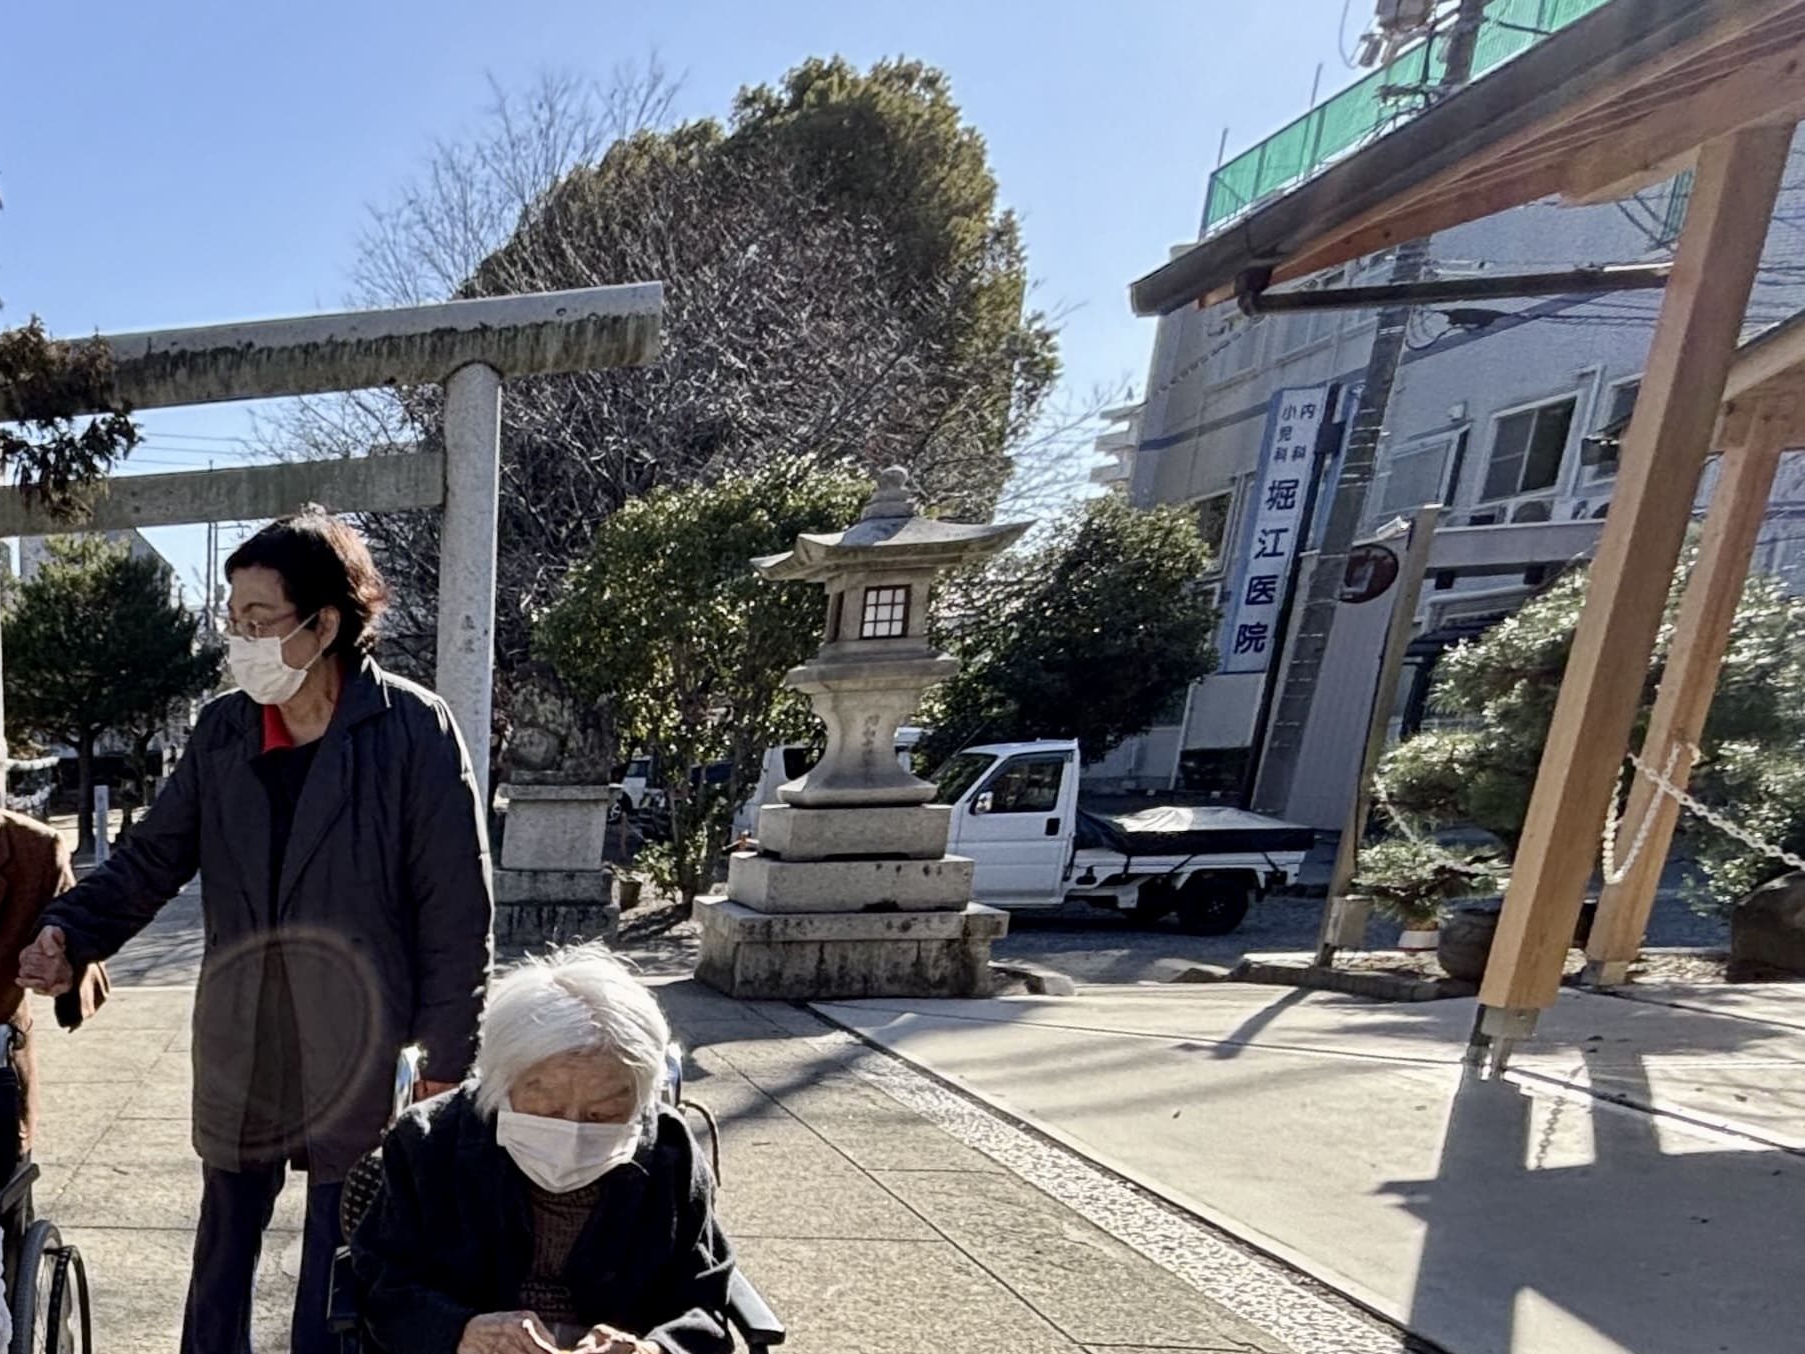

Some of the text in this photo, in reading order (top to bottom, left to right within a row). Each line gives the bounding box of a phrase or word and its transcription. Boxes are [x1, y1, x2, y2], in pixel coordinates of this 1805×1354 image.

[1274, 404, 1297, 463] 小児科
[1292, 402, 1317, 462] 内科
[1233, 478, 1299, 655] 堀江医院
